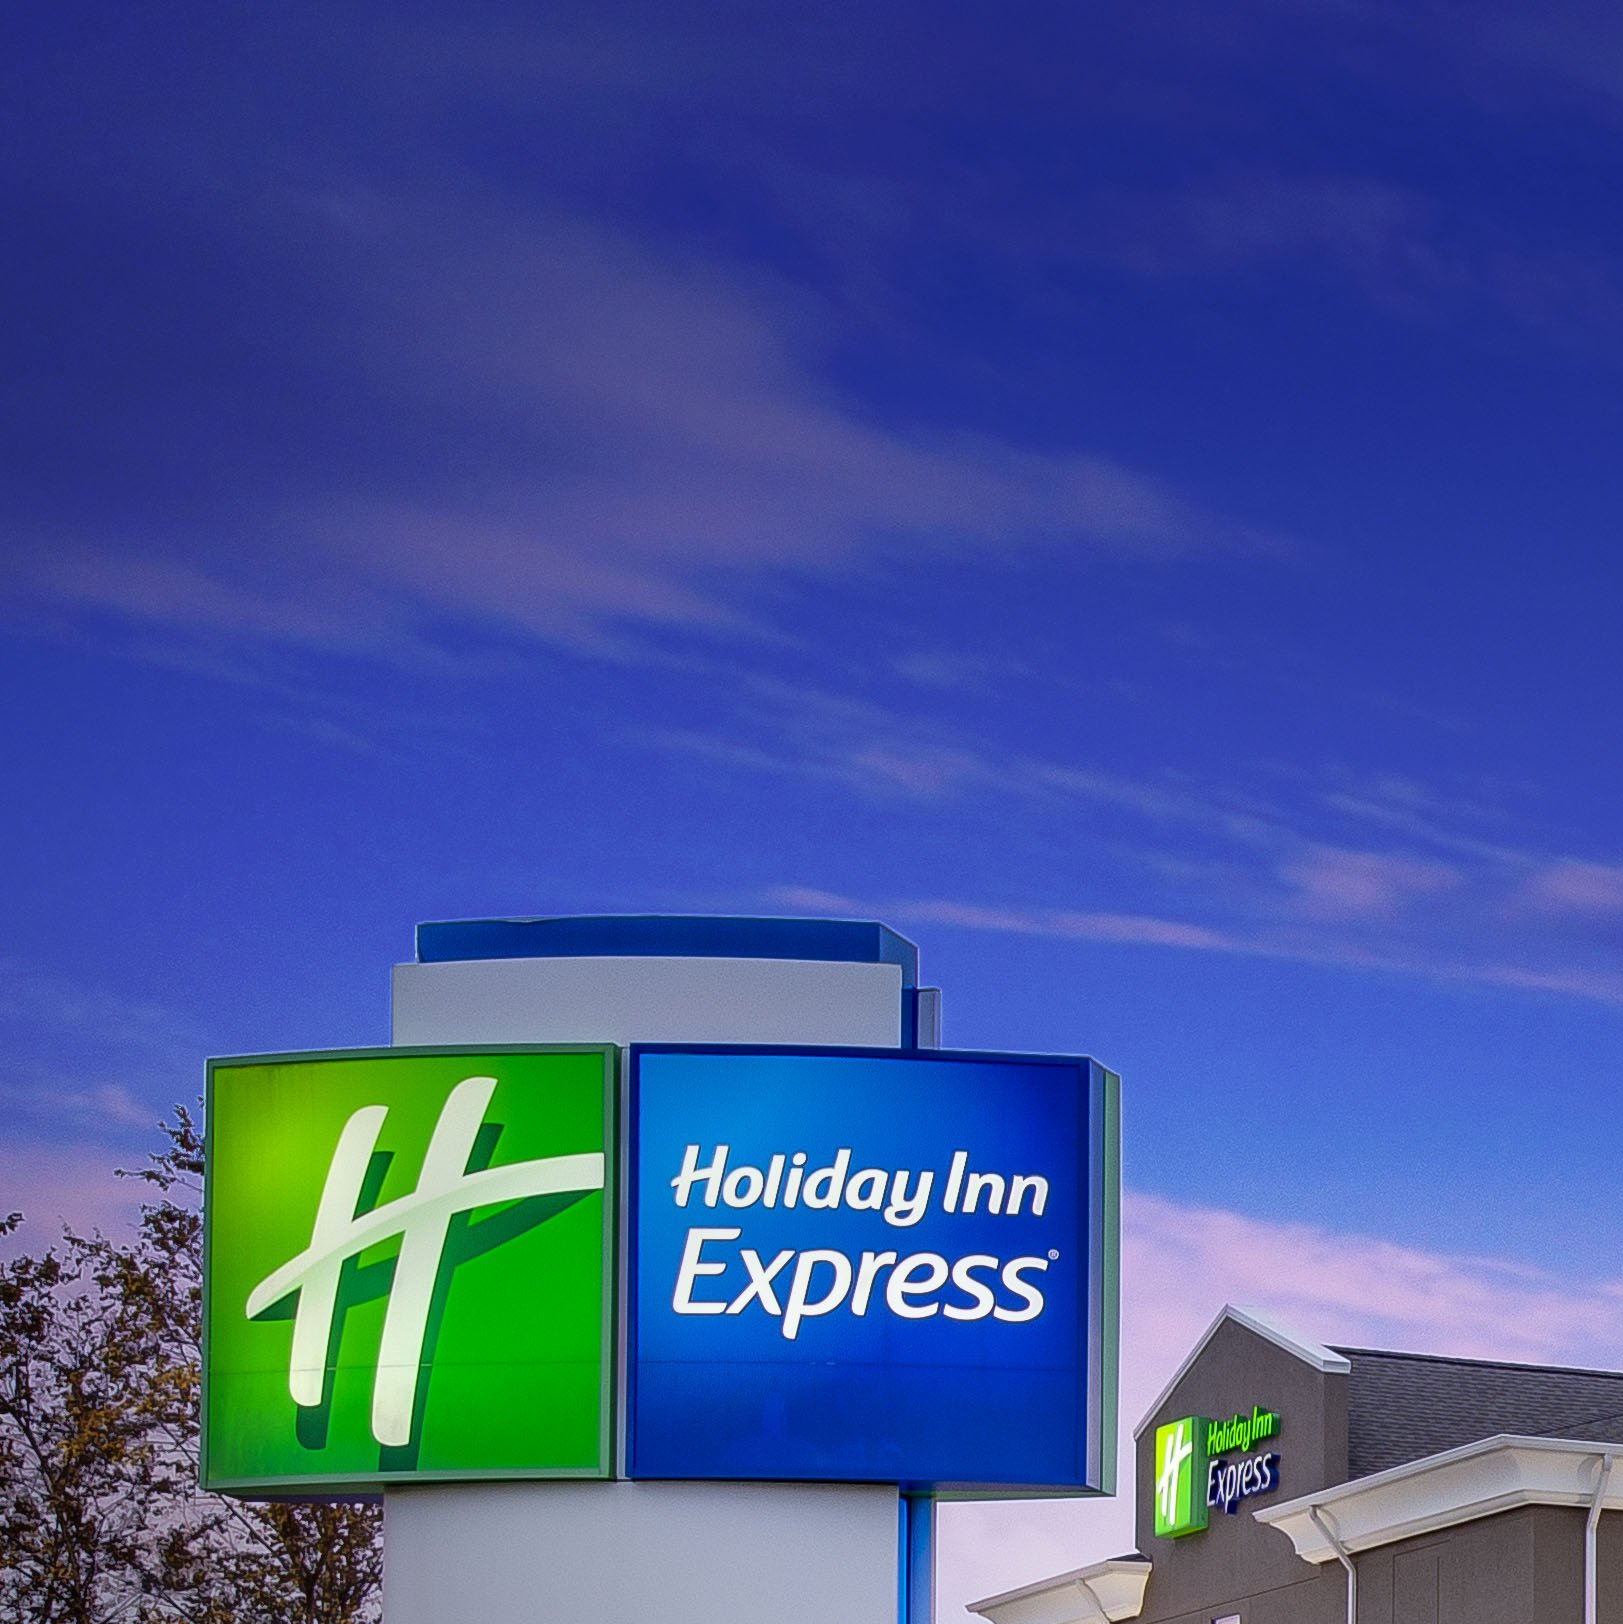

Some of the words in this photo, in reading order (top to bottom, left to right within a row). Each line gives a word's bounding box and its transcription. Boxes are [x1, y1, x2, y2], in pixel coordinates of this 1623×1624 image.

[670, 1144, 934, 1227] Holiday
[943, 1151, 1049, 1216] Inn
[1206, 1413, 1252, 1457] Holiday
[1251, 1405, 1274, 1442] Inn
[1206, 1452, 1273, 1514] Express
